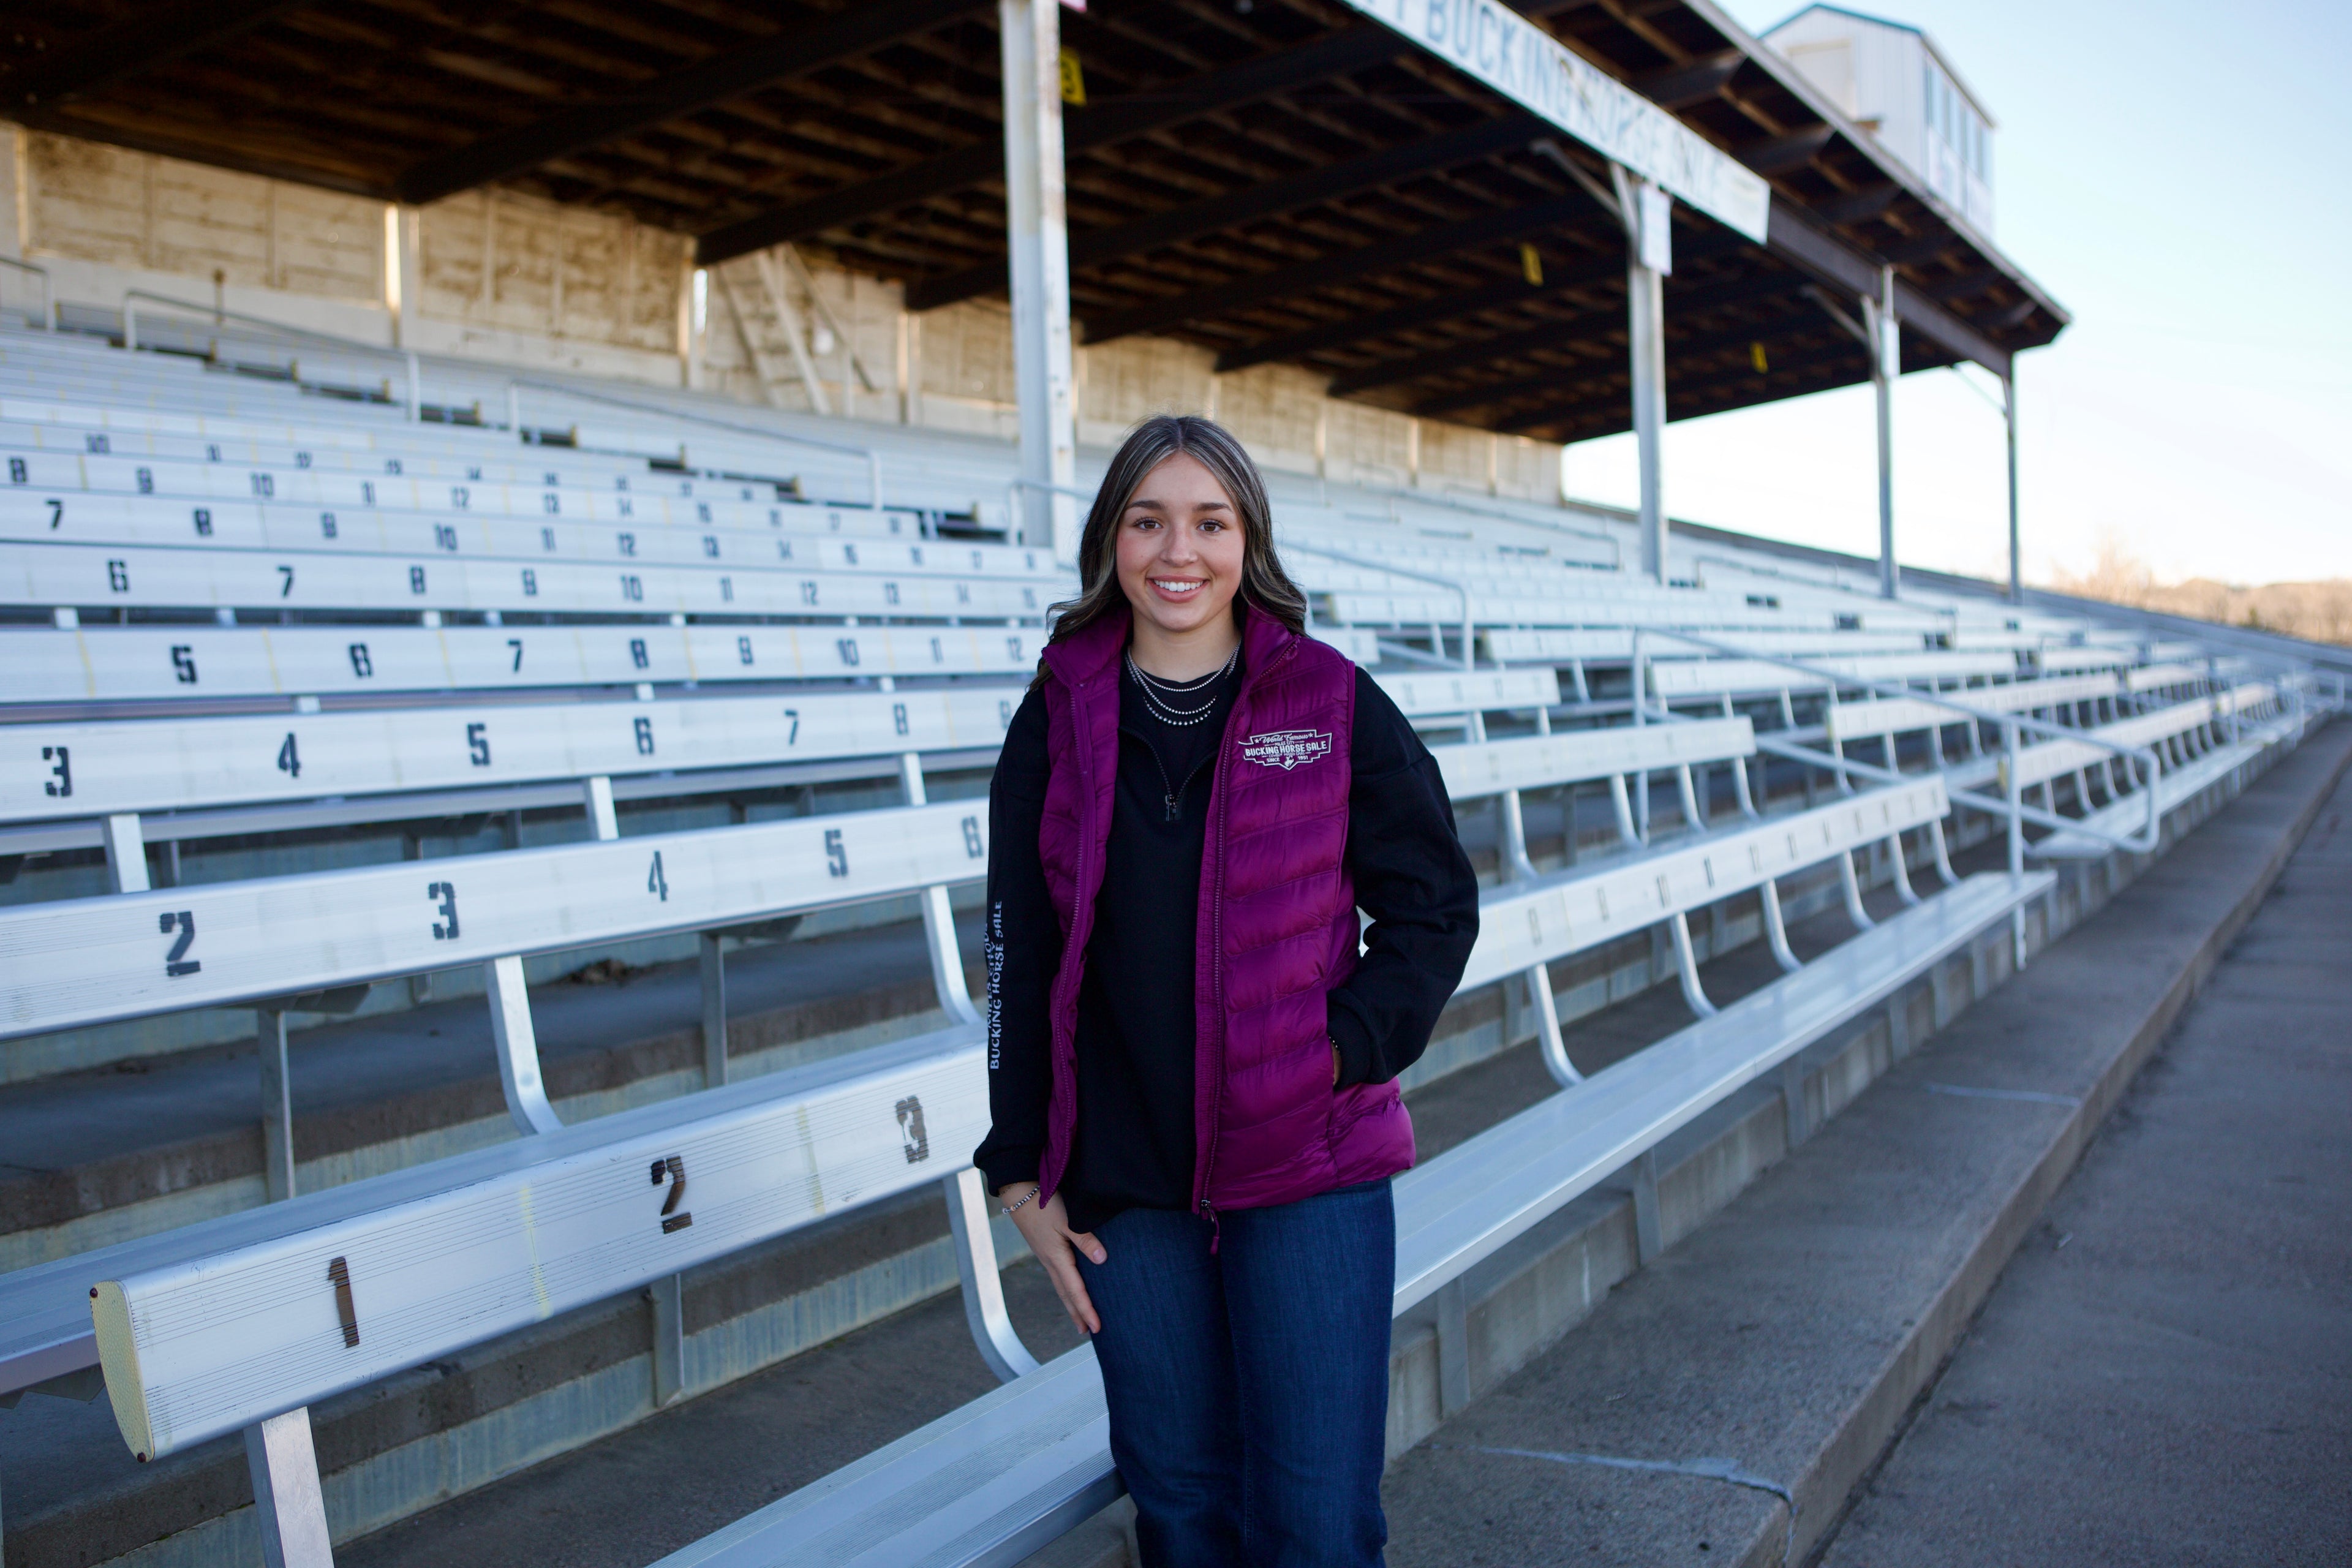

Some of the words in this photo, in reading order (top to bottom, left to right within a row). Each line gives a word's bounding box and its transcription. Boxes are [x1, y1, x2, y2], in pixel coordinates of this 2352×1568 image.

[251, 473, 273, 497] 10
[46, 500, 62, 529] 7
[194, 509, 212, 536] 8
[435, 524, 456, 551] 10
[541, 528, 555, 551] 11
[618, 533, 635, 556] 12
[108, 560, 129, 592] 6
[278, 567, 293, 597] 7
[410, 567, 425, 594] 8
[522, 570, 537, 595] 9
[620, 576, 643, 601] 10
[720, 578, 733, 601] 11
[801, 582, 818, 605] 12
[171, 646, 197, 684] 5
[508, 640, 521, 672] 7
[630, 639, 648, 668] 8
[837, 639, 859, 666] 10
[930, 638, 943, 663] 11
[1006, 637, 1024, 662] 12
[42, 747, 71, 797] 3
[278, 733, 300, 777] 4
[467, 723, 490, 766] 5
[634, 717, 654, 755] 6
[785, 710, 797, 745] 7
[893, 704, 908, 735] 8
[1245, 747, 1279, 756] BUCKING
[1280, 744, 1306, 753] HORSE
[1306, 741, 1327, 750] SALE
[1260, 734, 1283, 744] World
[159, 911, 200, 976] 2
[428, 882, 459, 939] 3
[649, 851, 667, 901] 4
[824, 829, 848, 877] 5
[962, 816, 983, 858] 6
[993, 900, 1003, 938] SALE
[992, 943, 1005, 993] HORSE
[989, 999, 1002, 1069] BUCKING
[326, 1257, 359, 1348] 1
[650, 1156, 692, 1234] 2
